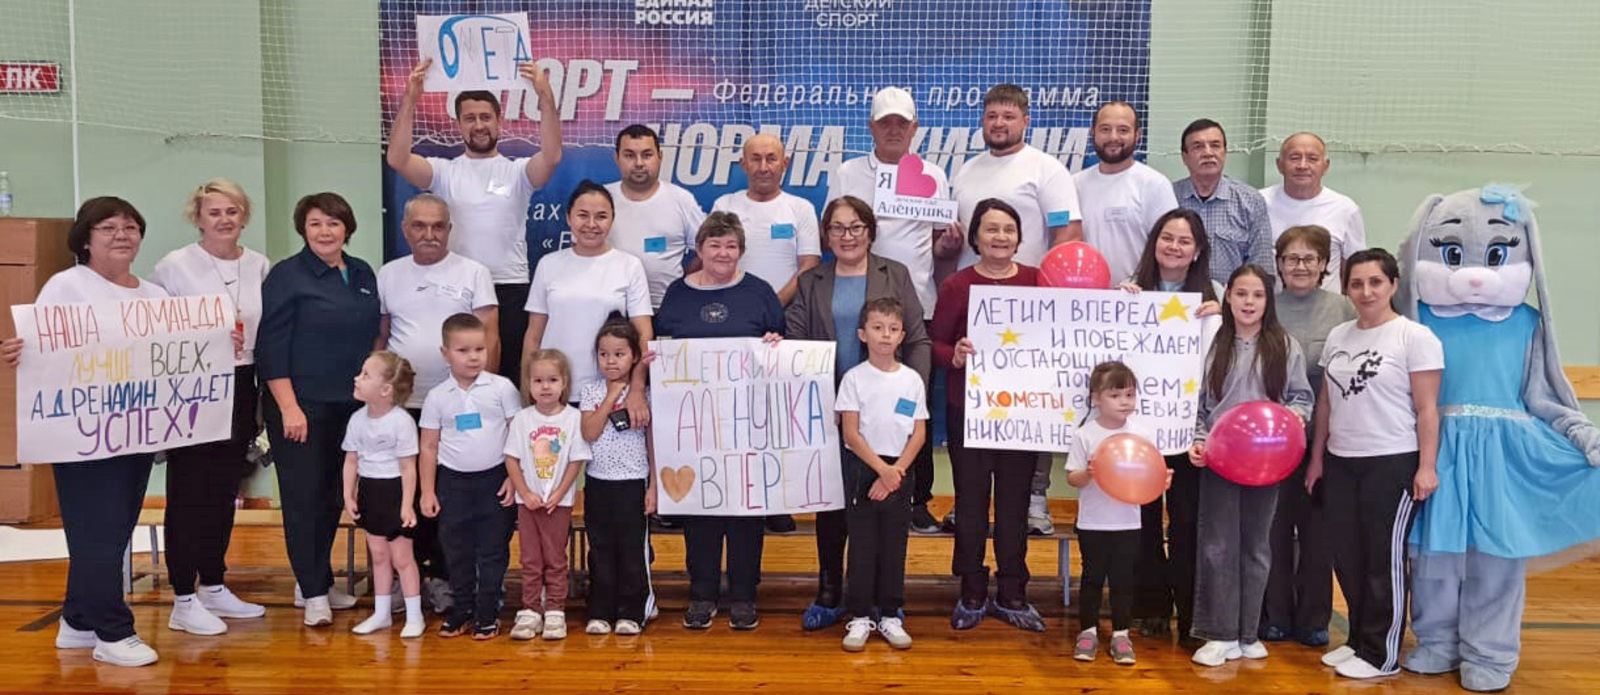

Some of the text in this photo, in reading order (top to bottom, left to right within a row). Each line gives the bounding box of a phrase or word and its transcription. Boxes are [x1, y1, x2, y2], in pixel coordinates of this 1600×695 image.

[635, 10, 713, 25] РОССИЯ
[816, 13, 878, 27] СПОРТ
[6, 67, 42, 89] ПК
[879, 172, 892, 189] Я
[877, 201, 953, 219] Алёнушка
[34, 296, 225, 354] НАША КОМАНДА
[973, 297, 1159, 328] ЛЕТИМ ВПЕРЕД
[1051, 329, 1199, 354] И ПОБЕЖДАЕМ
[69, 346, 136, 385] ЛУЧШЕ
[792, 346, 832, 377] САД
[972, 352, 985, 372] И
[31, 373, 234, 421] АДРЕНАЛИН ЖДЕТ
[77, 402, 199, 456] УСПЕХ!
[678, 380, 826, 453] АЛЕНУШКА
[967, 418, 1043, 443] НИКОГДА
[1050, 424, 1072, 446] НЕ
[700, 449, 832, 510] ВПЕРЕД
